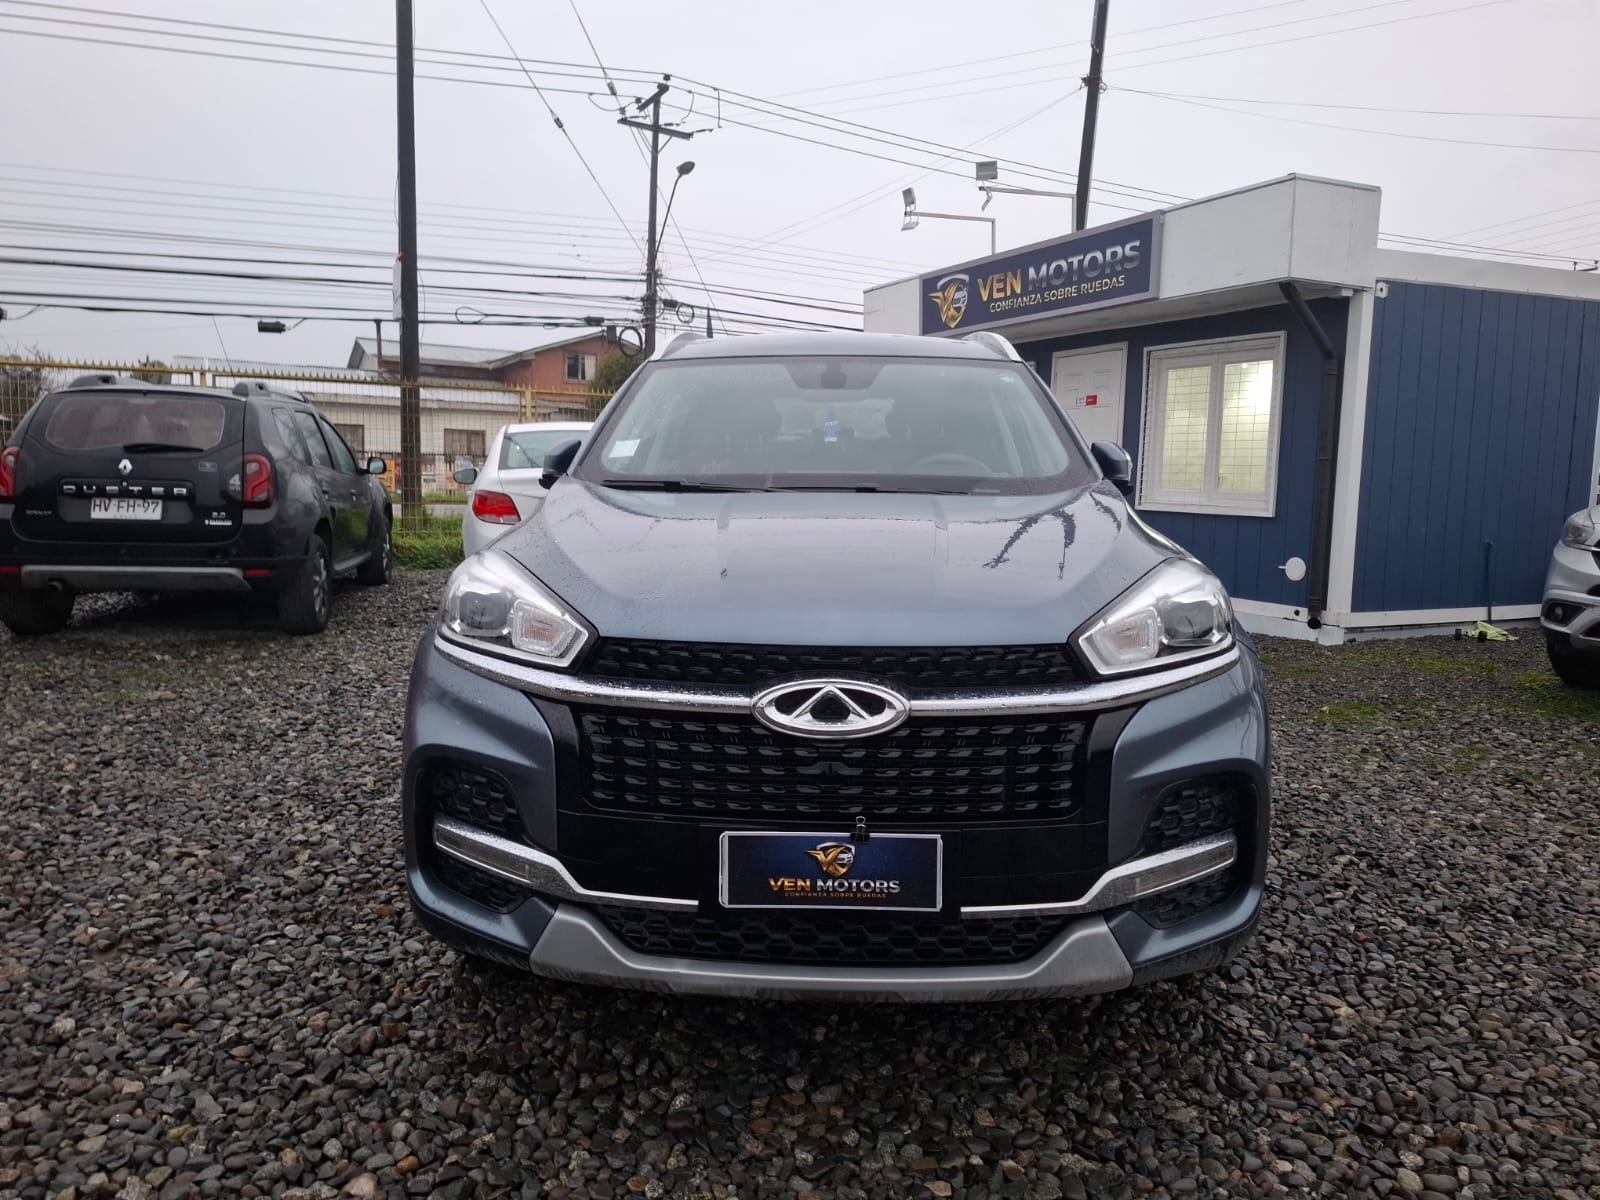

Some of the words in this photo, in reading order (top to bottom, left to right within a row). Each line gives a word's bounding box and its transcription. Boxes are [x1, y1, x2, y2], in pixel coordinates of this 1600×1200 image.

[977, 268, 1022, 302] VEN
[1028, 239, 1141, 291] MOTORS
[989, 294, 1042, 313] CONFIANZA
[1044, 285, 1078, 302] SOBRE
[1080, 275, 1126, 294] RUEDAS
[768, 878, 811, 891] VEN
[816, 879, 901, 893] MOTORS
